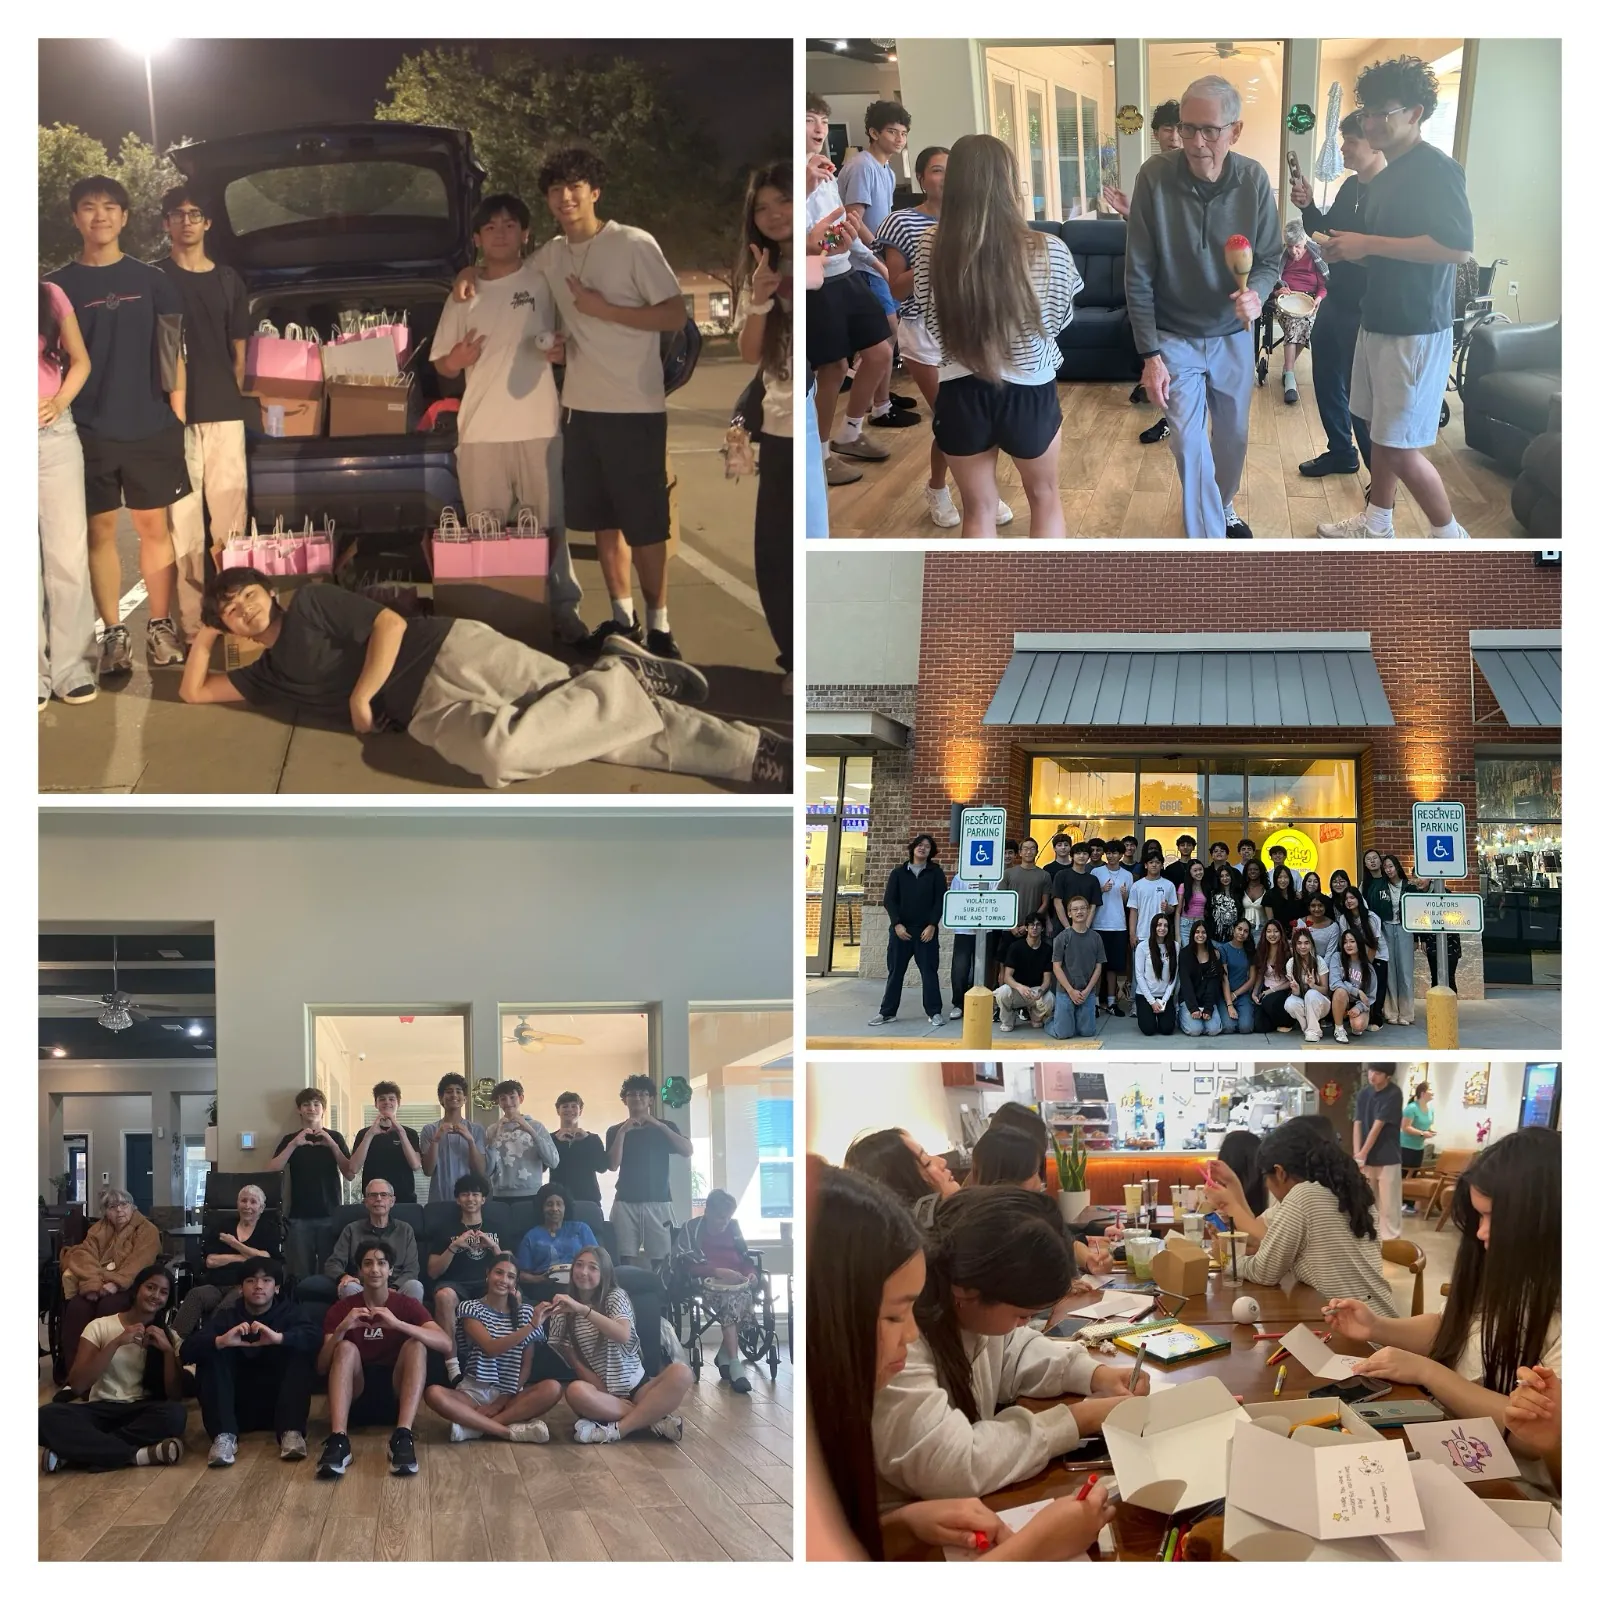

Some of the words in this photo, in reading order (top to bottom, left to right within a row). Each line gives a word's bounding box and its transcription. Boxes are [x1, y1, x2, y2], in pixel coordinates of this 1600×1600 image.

[1417, 809, 1461, 820] RESERVED
[965, 815, 1003, 825] RESERVED
[966, 827, 1000, 837] PARKING
[1420, 822, 1459, 833] PARKING
